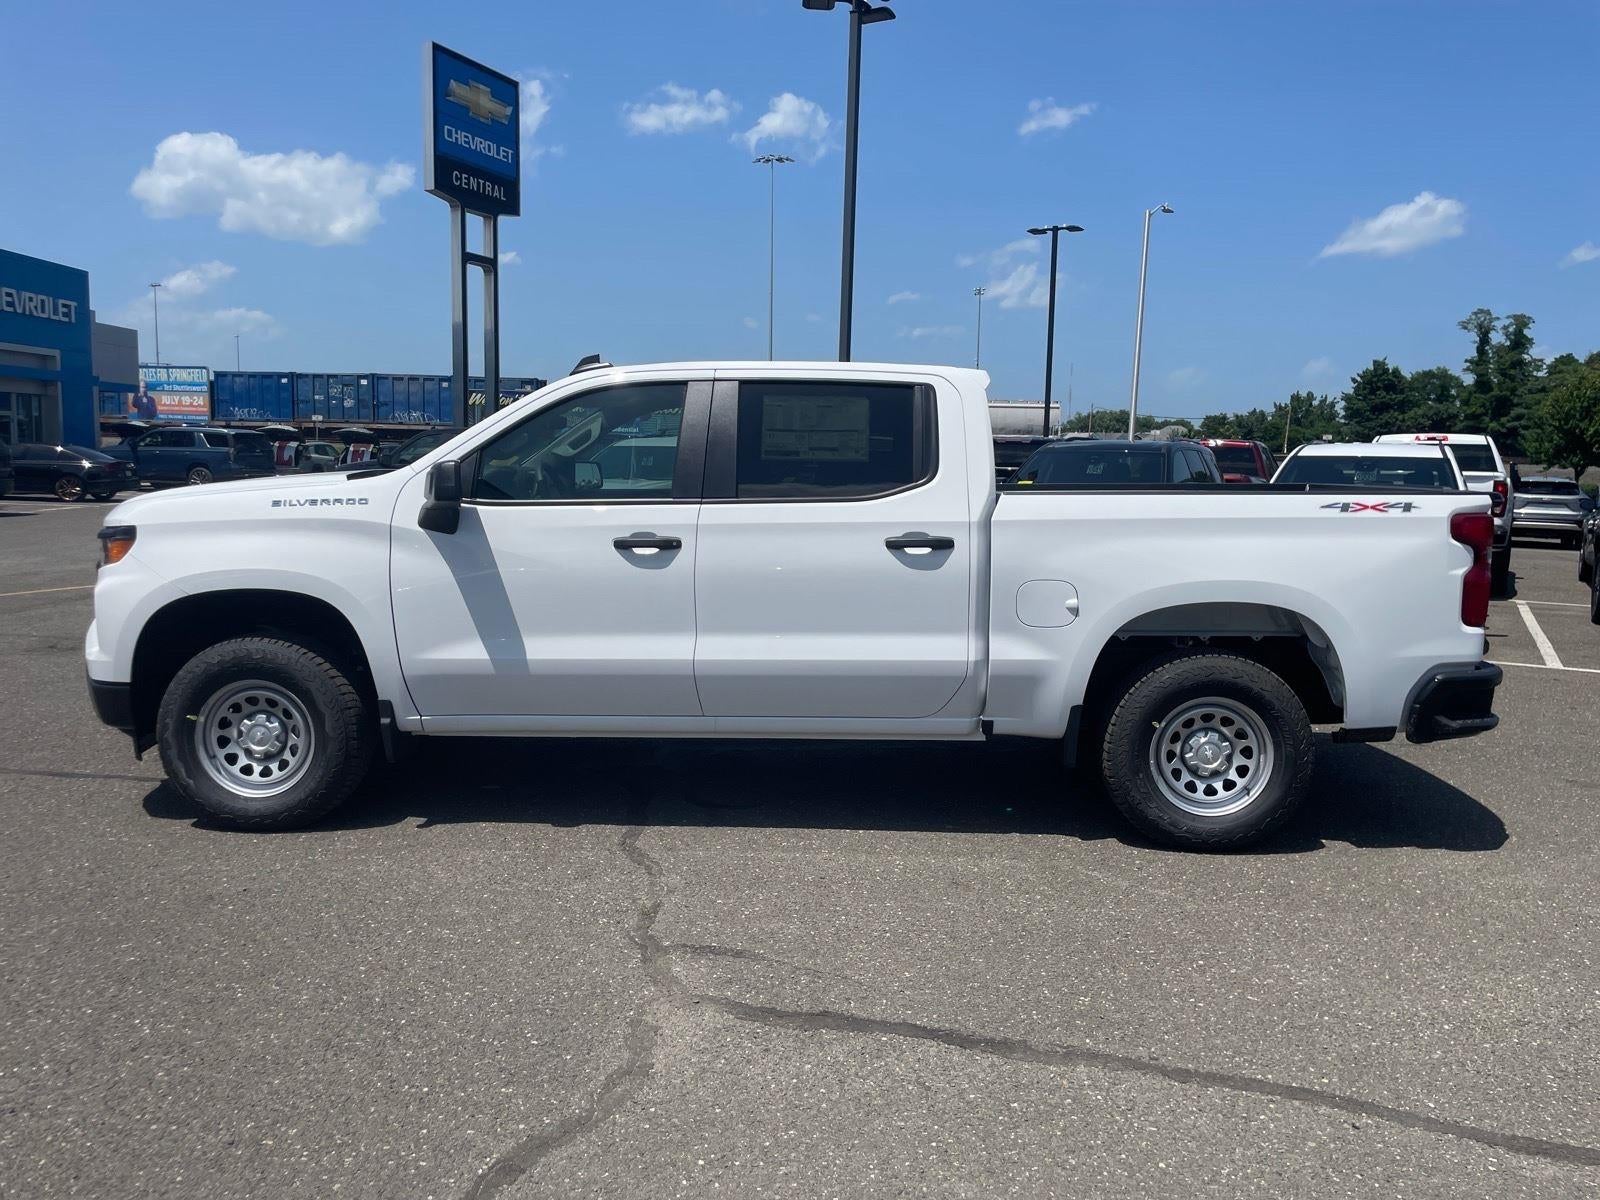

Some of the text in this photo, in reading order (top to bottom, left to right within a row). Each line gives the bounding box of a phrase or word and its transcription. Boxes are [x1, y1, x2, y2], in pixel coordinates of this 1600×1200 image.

[443, 124, 513, 164] CHEVROLET
[452, 170, 507, 201] CENTRAL
[169, 368, 208, 382] SPRINGFIELD
[161, 395, 204, 406] JULY 19-24
[271, 497, 369, 508] SILVERADO
